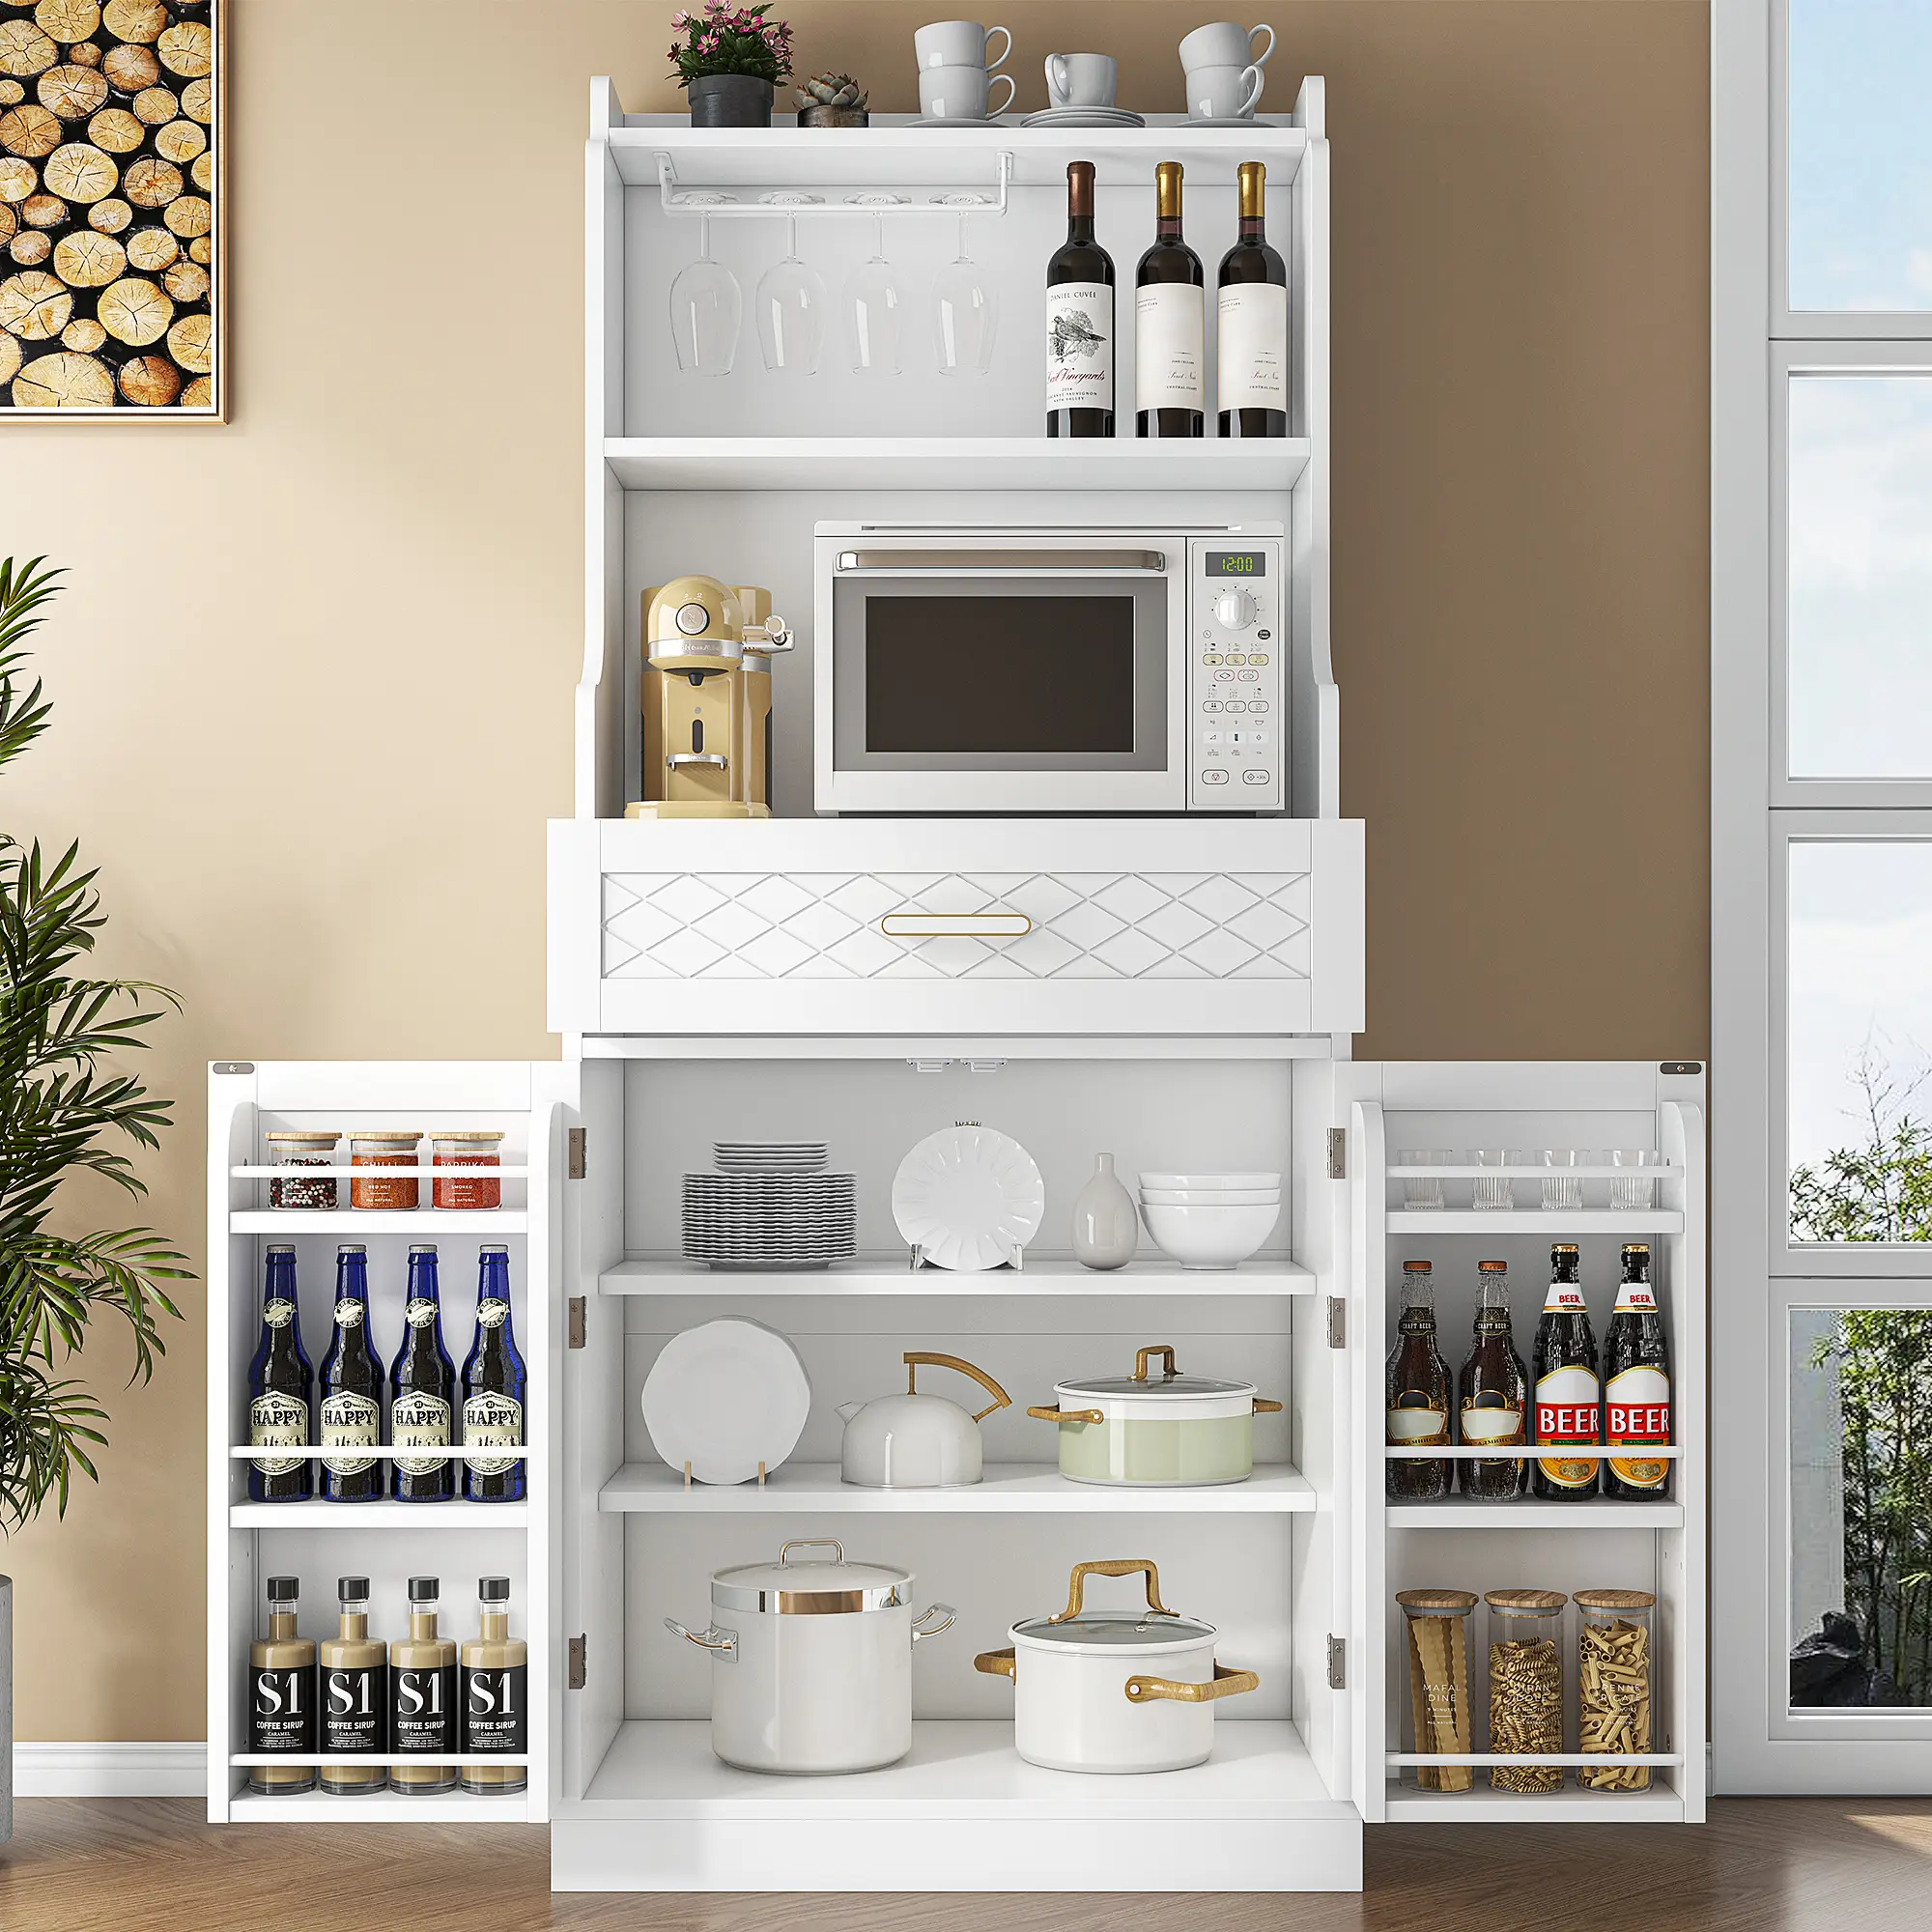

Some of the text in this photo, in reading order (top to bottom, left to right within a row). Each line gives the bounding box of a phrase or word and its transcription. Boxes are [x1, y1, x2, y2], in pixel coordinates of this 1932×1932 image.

[1057, 367, 1105, 384] Vineyards
[1222, 556, 1253, 572] 12:00
[1559, 1294, 1580, 1304] BEER
[1630, 1294, 1652, 1304] BEER
[253, 1409, 303, 1426] HAPPY
[325, 1409, 374, 1426] HAPPY
[396, 1409, 446, 1426] HAPPY
[468, 1409, 517, 1426] HAPPY
[1540, 1407, 1600, 1434] BEER
[1610, 1407, 1669, 1434] BEER
[257, 1673, 301, 1715] S1
[327, 1673, 373, 1715] S1
[398, 1673, 443, 1715] S1
[469, 1673, 515, 1715] S1
[257, 1720, 303, 1730] COFFEE SIRUP
[327, 1720, 375, 1730] COFFEE SIRUP
[398, 1720, 445, 1730] COFFEE SIRUP
[469, 1720, 517, 1730] COFFEE SIRUP
